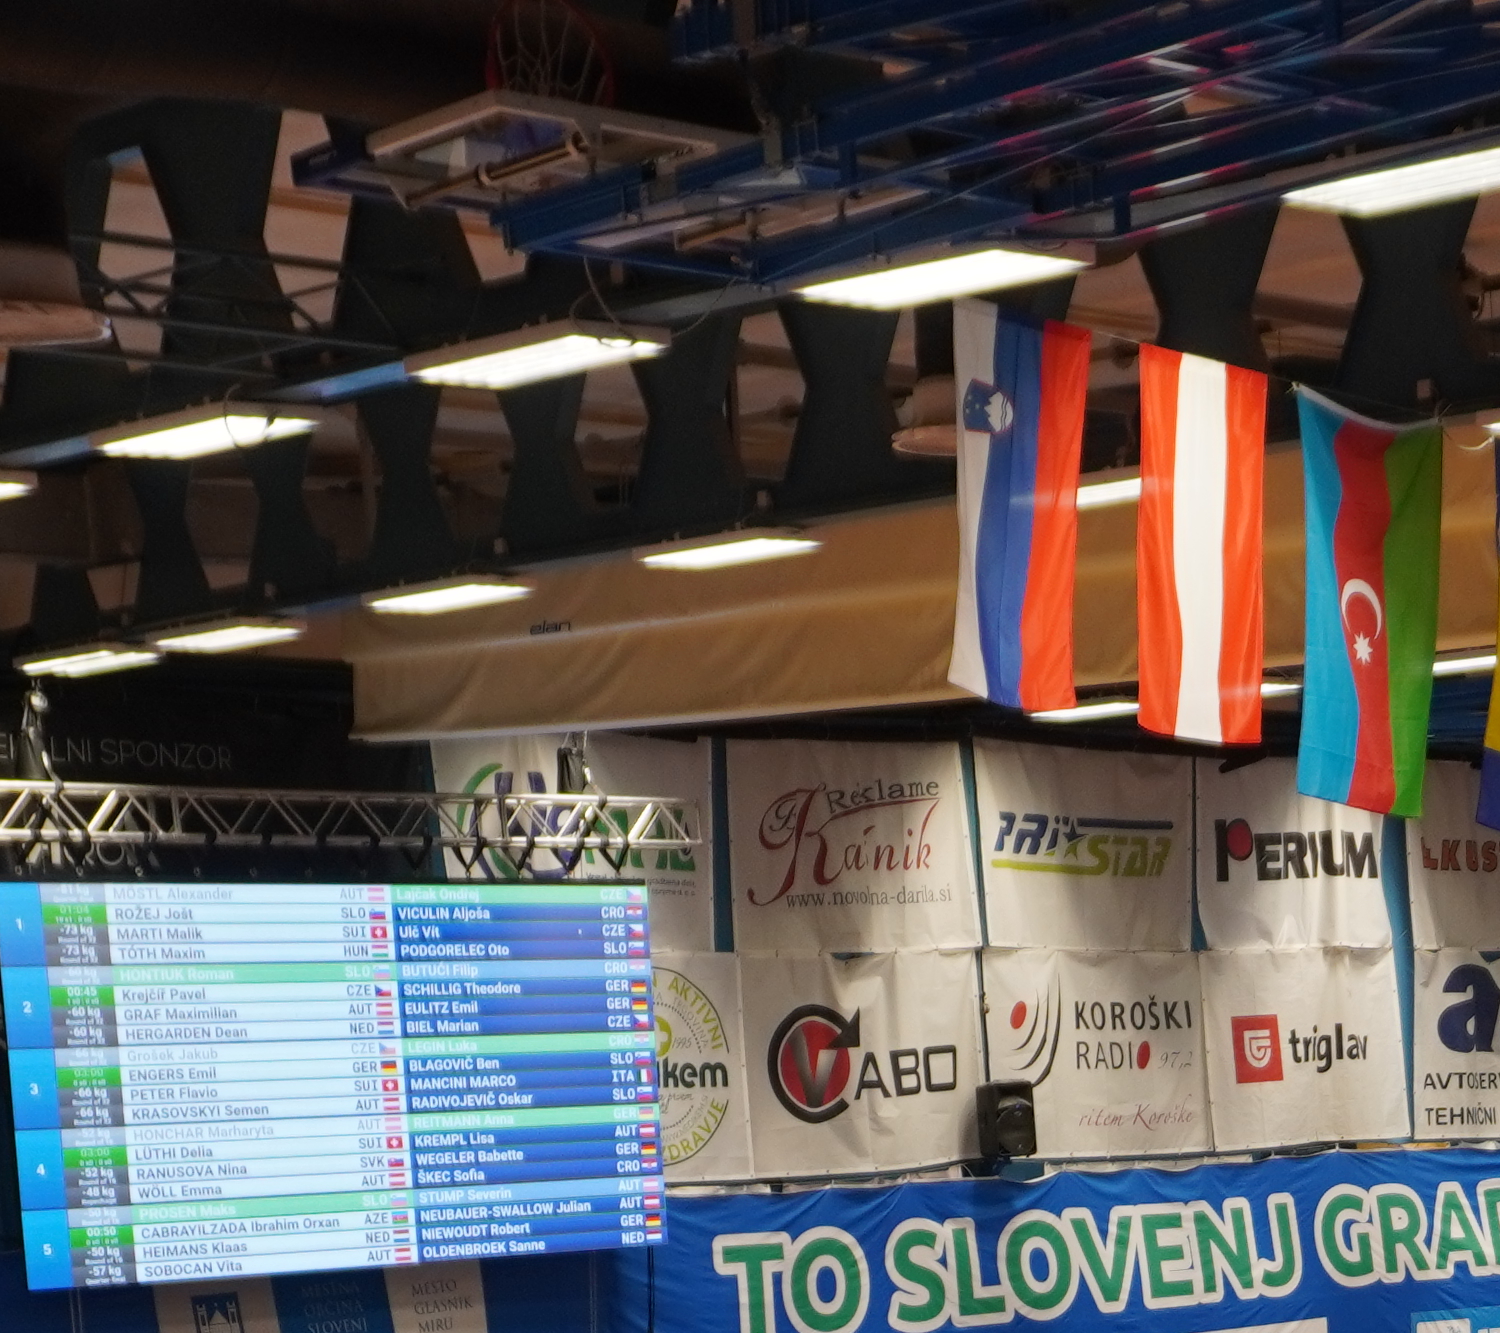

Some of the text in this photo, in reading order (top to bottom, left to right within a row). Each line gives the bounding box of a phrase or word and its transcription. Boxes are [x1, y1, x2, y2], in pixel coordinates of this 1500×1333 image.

[1215, 818, 1379, 882] PERIUM
[401, 945, 485, 956] PODGORELEC
[604, 942, 627, 954] SLO
[348, 1004, 372, 1015] AUT
[406, 1001, 478, 1014] EULITZ Emil
[607, 998, 629, 1009] GER
[124, 1009, 161, 1021] GRAF
[668, 976, 724, 1050] AKTIVNI
[1075, 995, 1192, 1031] KOROŠKI
[1289, 1023, 1367, 1074] triglav
[411, 1076, 515, 1090] MANCINI MARCO
[612, 1071, 634, 1082] ITA
[1425, 1102, 1497, 1126] TEHNIČNI
[615, 1125, 637, 1136] AUT
[415, 1134, 494, 1147] KREMPL Lisa
[617, 1160, 639, 1172] CRO
[418, 1170, 485, 1183] ŠKEC Sofia
[621, 1215, 643, 1226] GER
[422, 1223, 530, 1239] NIEWOUDT Robert
[622, 1232, 644, 1244] NED
[423, 1240, 545, 1258] OLDENBROEK Sanne
[885, 1191, 1302, 1333] SLOVENJ
[419, 1318, 453, 1333] MIRU
